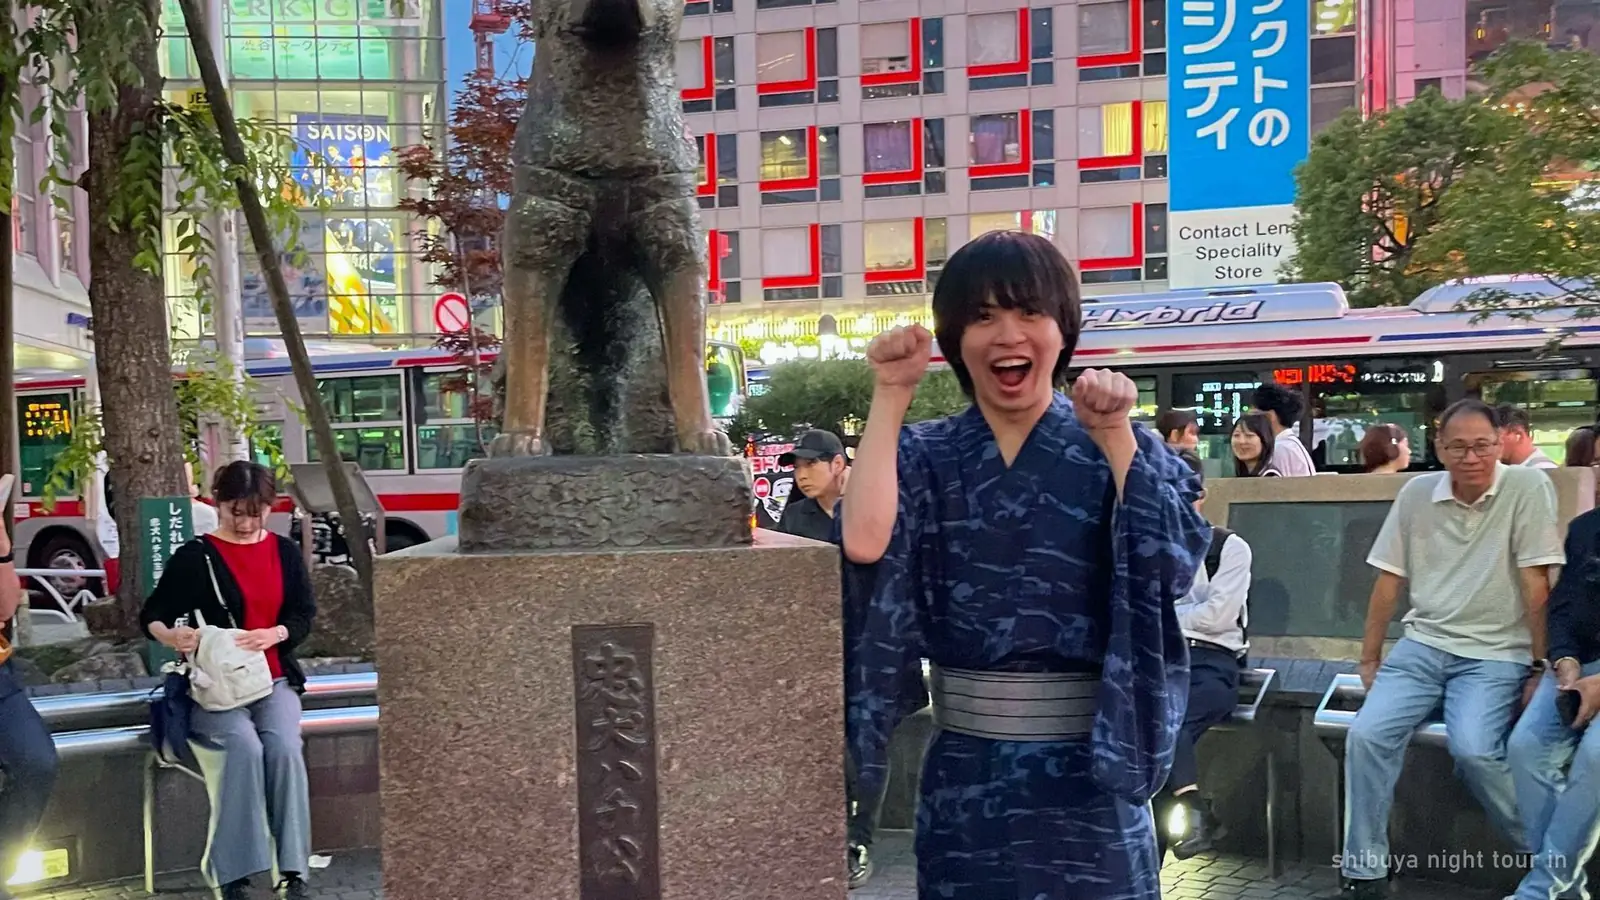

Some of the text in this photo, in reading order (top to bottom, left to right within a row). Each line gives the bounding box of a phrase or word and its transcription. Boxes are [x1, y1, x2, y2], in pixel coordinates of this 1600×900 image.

[1248, 0, 1291, 147] クトの
[307, 121, 391, 142] SAISON
[1179, 223, 1248, 241] Contact
[1196, 242, 1282, 260] Speciality
[1214, 266, 1263, 280] Store
[1081, 299, 1266, 330] Hybrid
[150, 517, 163, 588] 忠犬ハチ公
